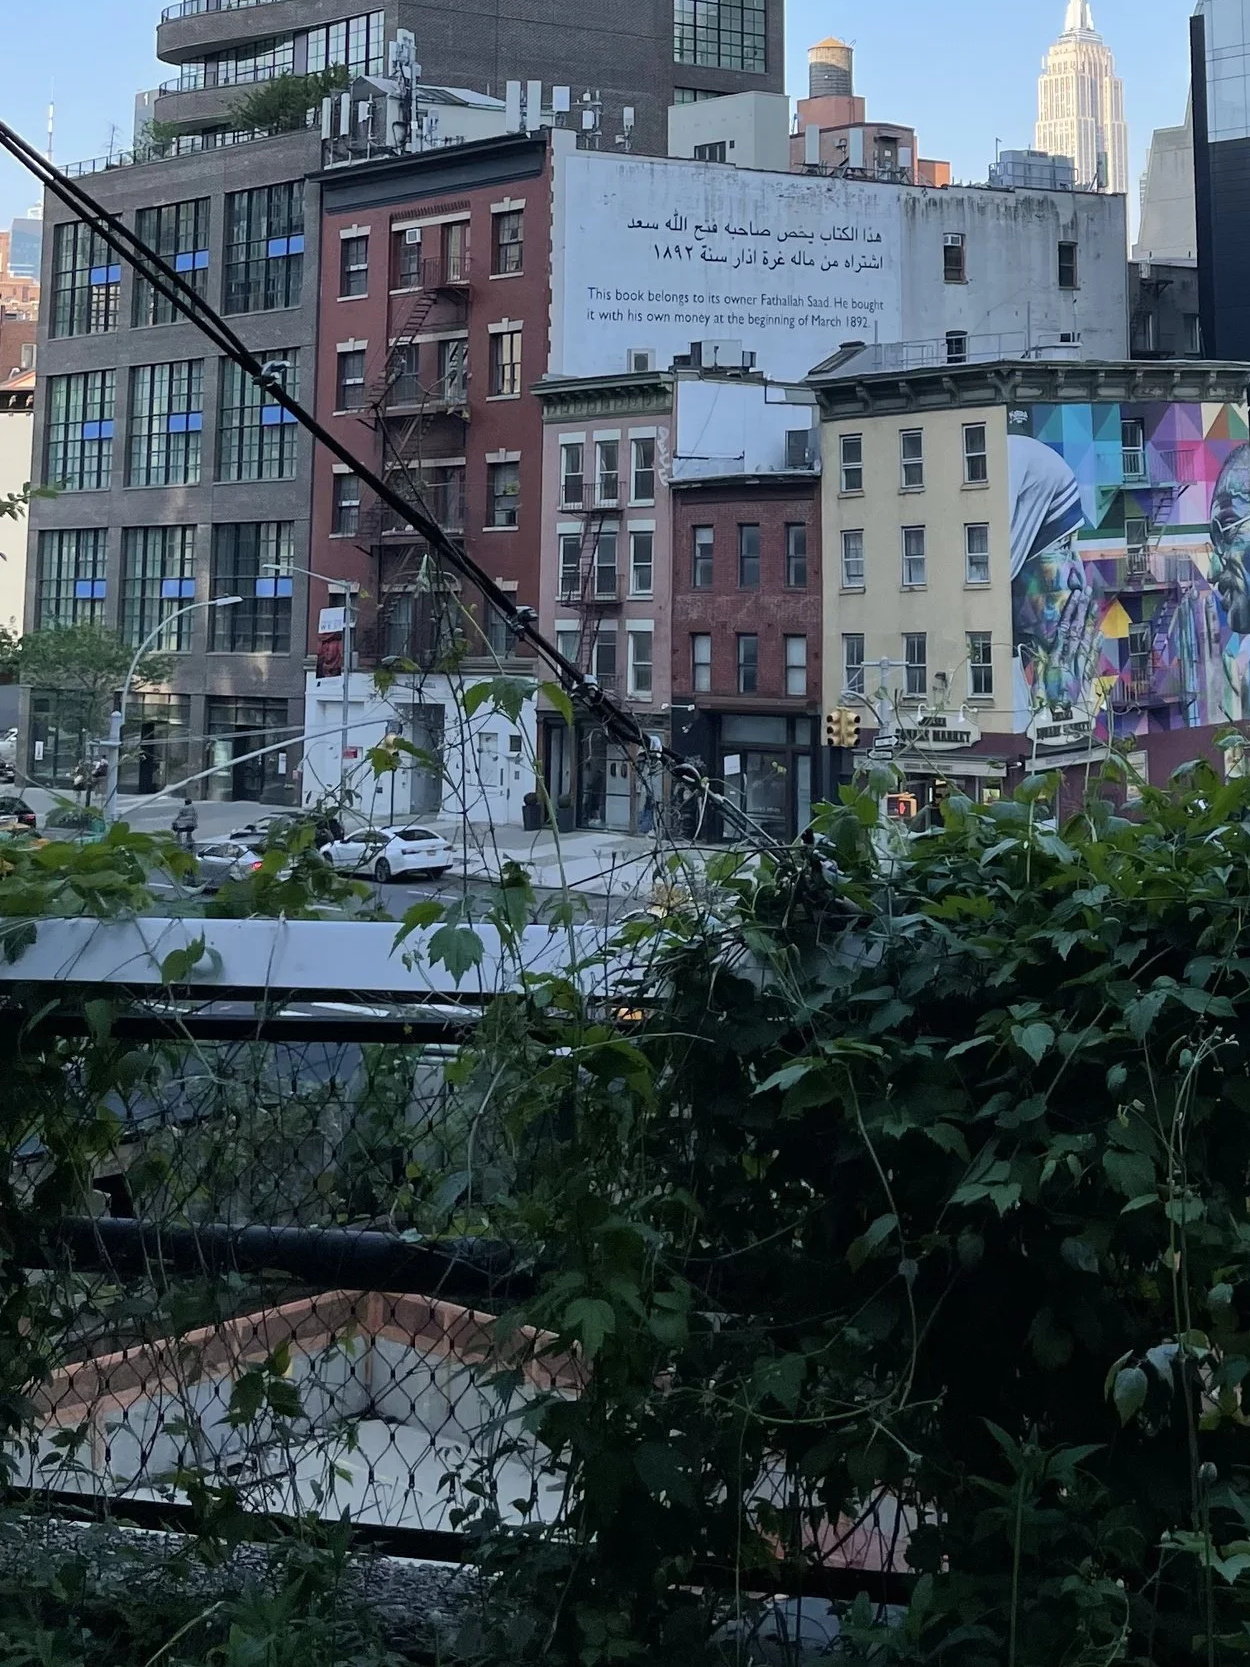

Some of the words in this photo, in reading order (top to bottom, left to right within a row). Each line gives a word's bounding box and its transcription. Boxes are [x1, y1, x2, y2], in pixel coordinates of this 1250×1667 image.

[627, 217, 659, 230] سعد
[694, 218, 718, 241] فتح
[724, 221, 771, 240] صاحبه
[777, 225, 814, 244] يخص
[820, 226, 858, 246] الكتاب
[863, 226, 882, 243] هذا
[654, 243, 694, 261] ١٨٩٢
[700, 245, 728, 263] سنة
[731, 248, 757, 269] اذار
[763, 250, 786, 270] غرة
[791, 249, 815, 266] ماله
[821, 254, 839, 271] من
[844, 253, 883, 273] اشتراه
[587, 286, 612, 301] This
[615, 288, 645, 302] book
[648, 290, 689, 306] belongs
[693, 294, 705, 304] to
[708, 292, 721, 304] its
[724, 295, 758, 305] owner
[761, 294, 804, 307] Fathallah
[834, 297, 849, 309] He
[851, 298, 884, 313] bought
[586, 308, 595, 321] it
[599, 309, 624, 322] with
[628, 308, 643, 322] his
[647, 313, 671, 323] own
[675, 313, 711, 327] money
[714, 314, 725, 324] at
[728, 312, 745, 325] the
[748, 313, 796, 329] beginning
[798, 314, 809, 326] of
[812, 315, 842, 328] March
